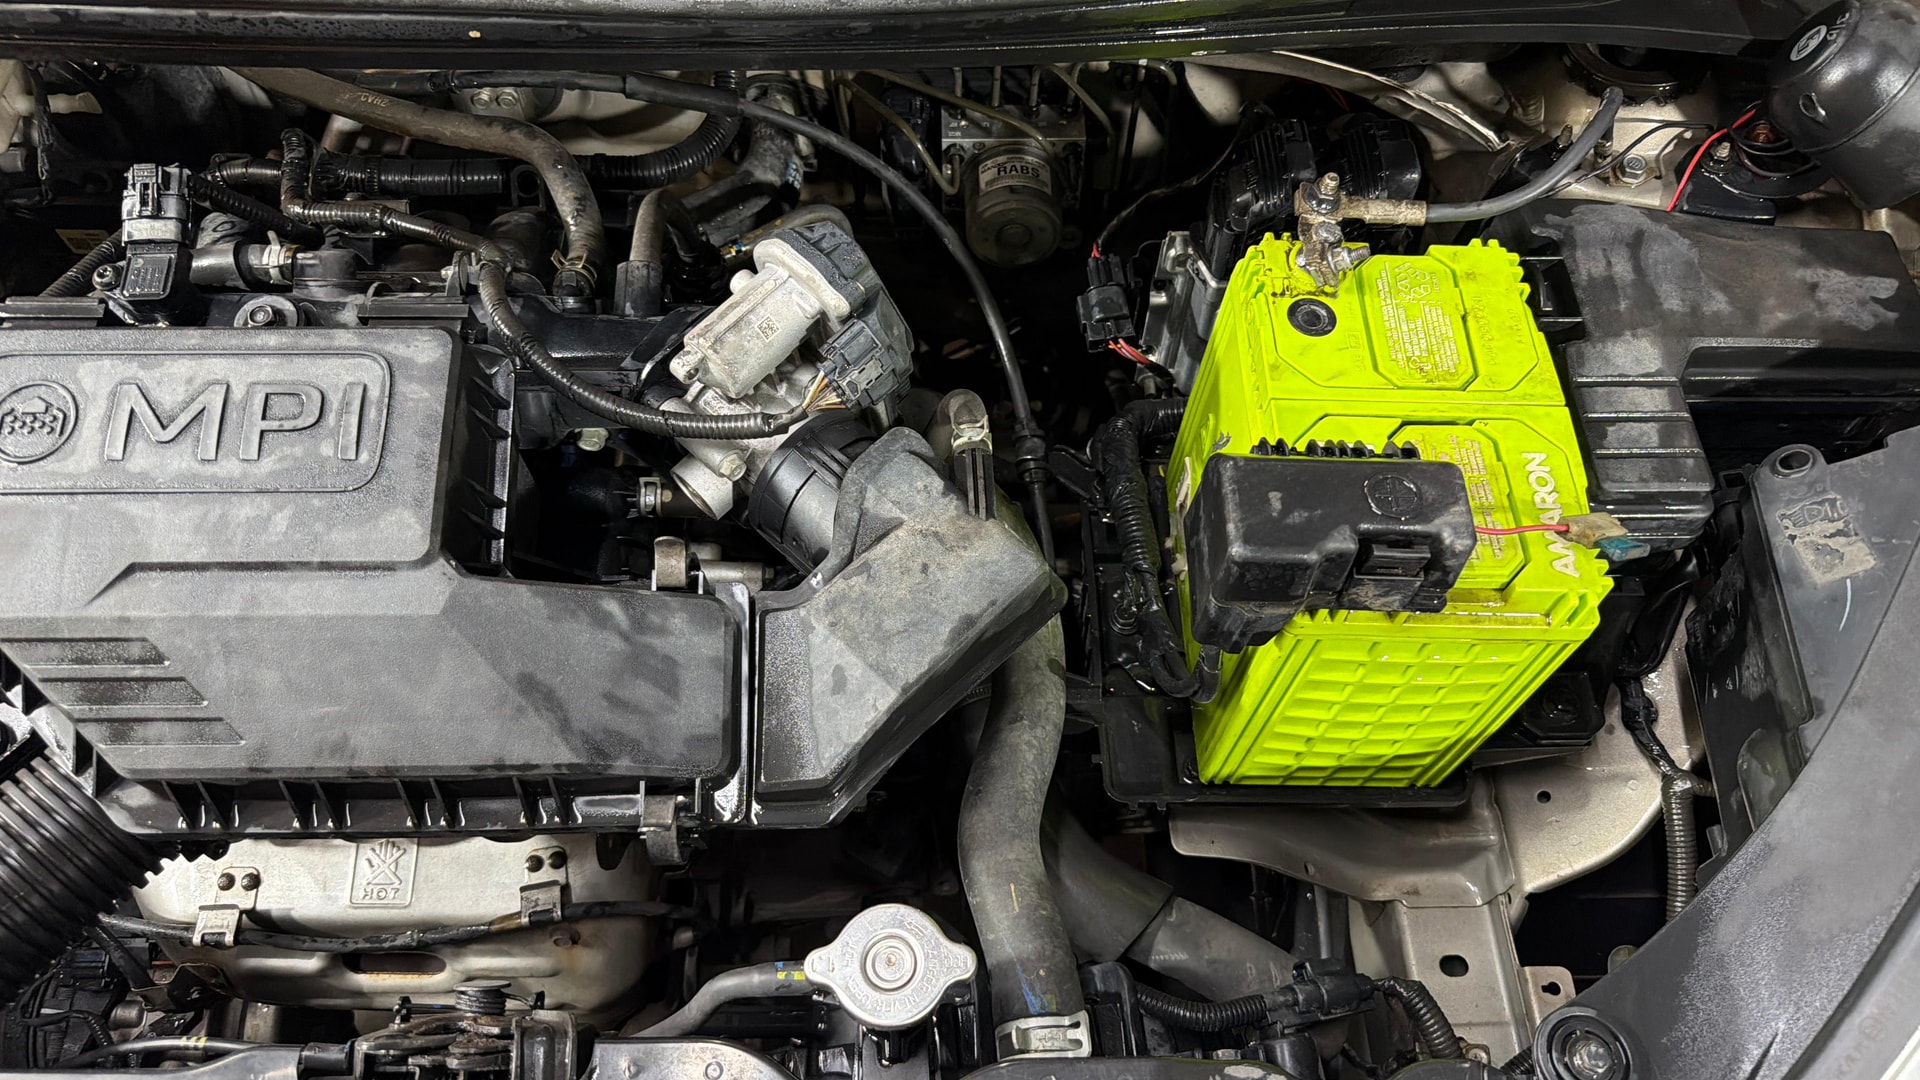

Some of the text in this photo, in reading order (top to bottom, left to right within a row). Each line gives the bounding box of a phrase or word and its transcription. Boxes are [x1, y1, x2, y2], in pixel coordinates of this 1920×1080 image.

[997, 164, 1040, 178] RABS
[104, 382, 366, 461] MPI
[1521, 452, 1580, 578] AMARON
[362, 887, 400, 900] HOT
